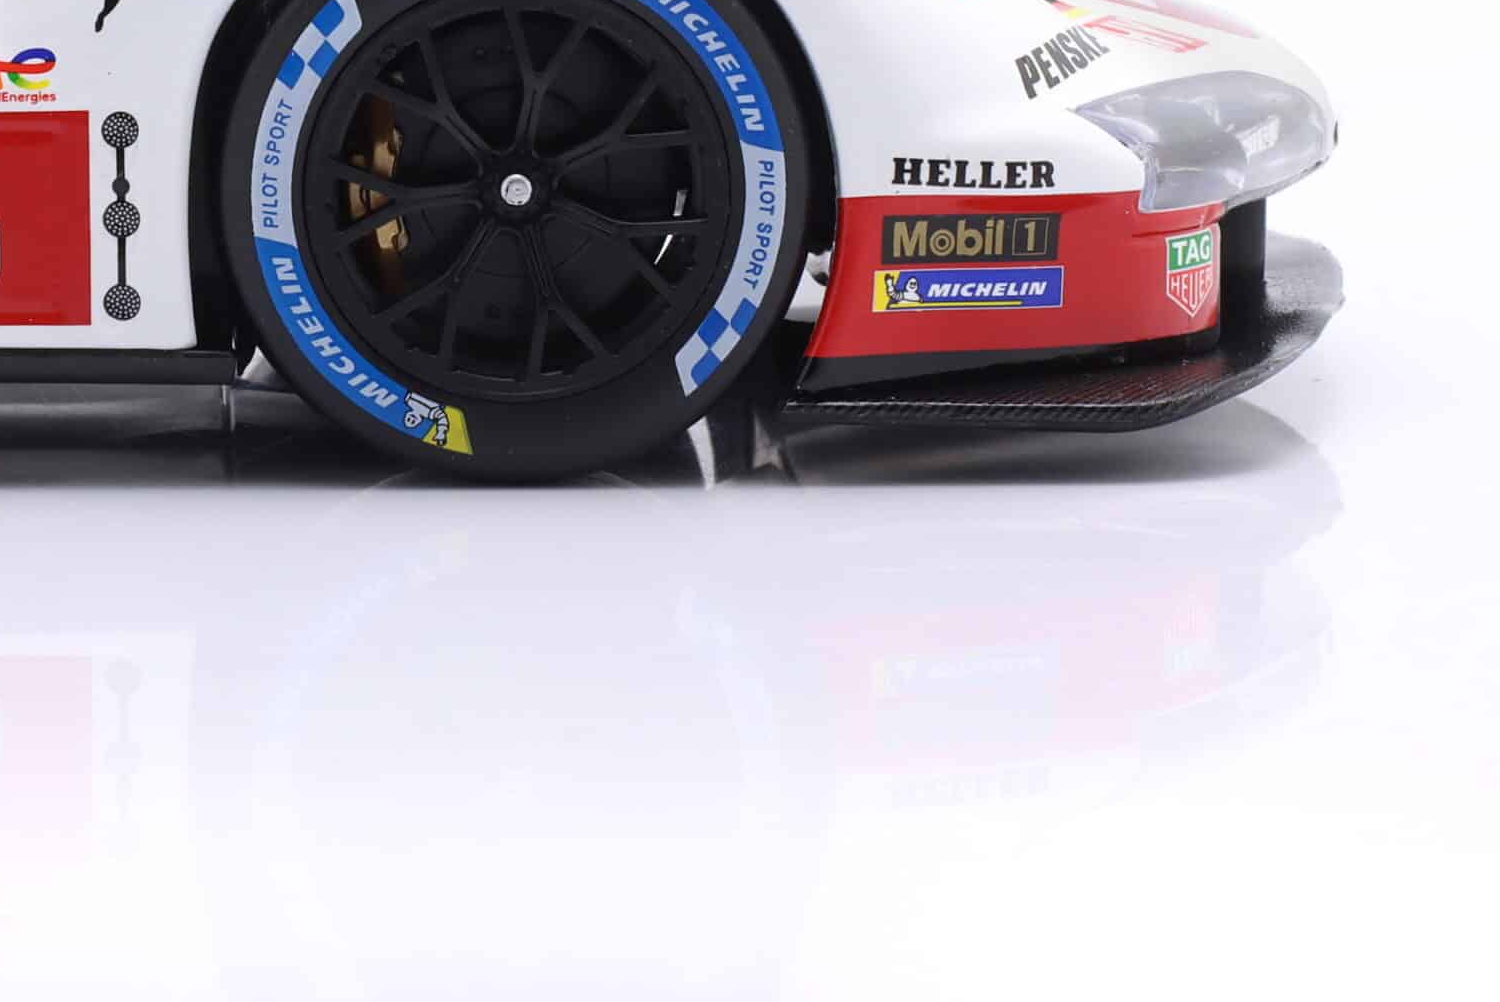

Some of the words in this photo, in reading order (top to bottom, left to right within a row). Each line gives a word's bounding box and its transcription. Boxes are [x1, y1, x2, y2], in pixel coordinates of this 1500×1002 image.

[1015, 24, 1111, 100] PENSKE
[264, 99, 293, 166] SPORT
[261, 172, 279, 228] PILOT
[758, 160, 776, 216] PILOT
[892, 158, 1055, 188] HELLER
[743, 222, 772, 290] SPORT
[893, 219, 1005, 258] Mobil
[1171, 235, 1210, 266] TAG
[927, 281, 1047, 298] MICHELIN
[272, 257, 399, 408] MICHELIN
